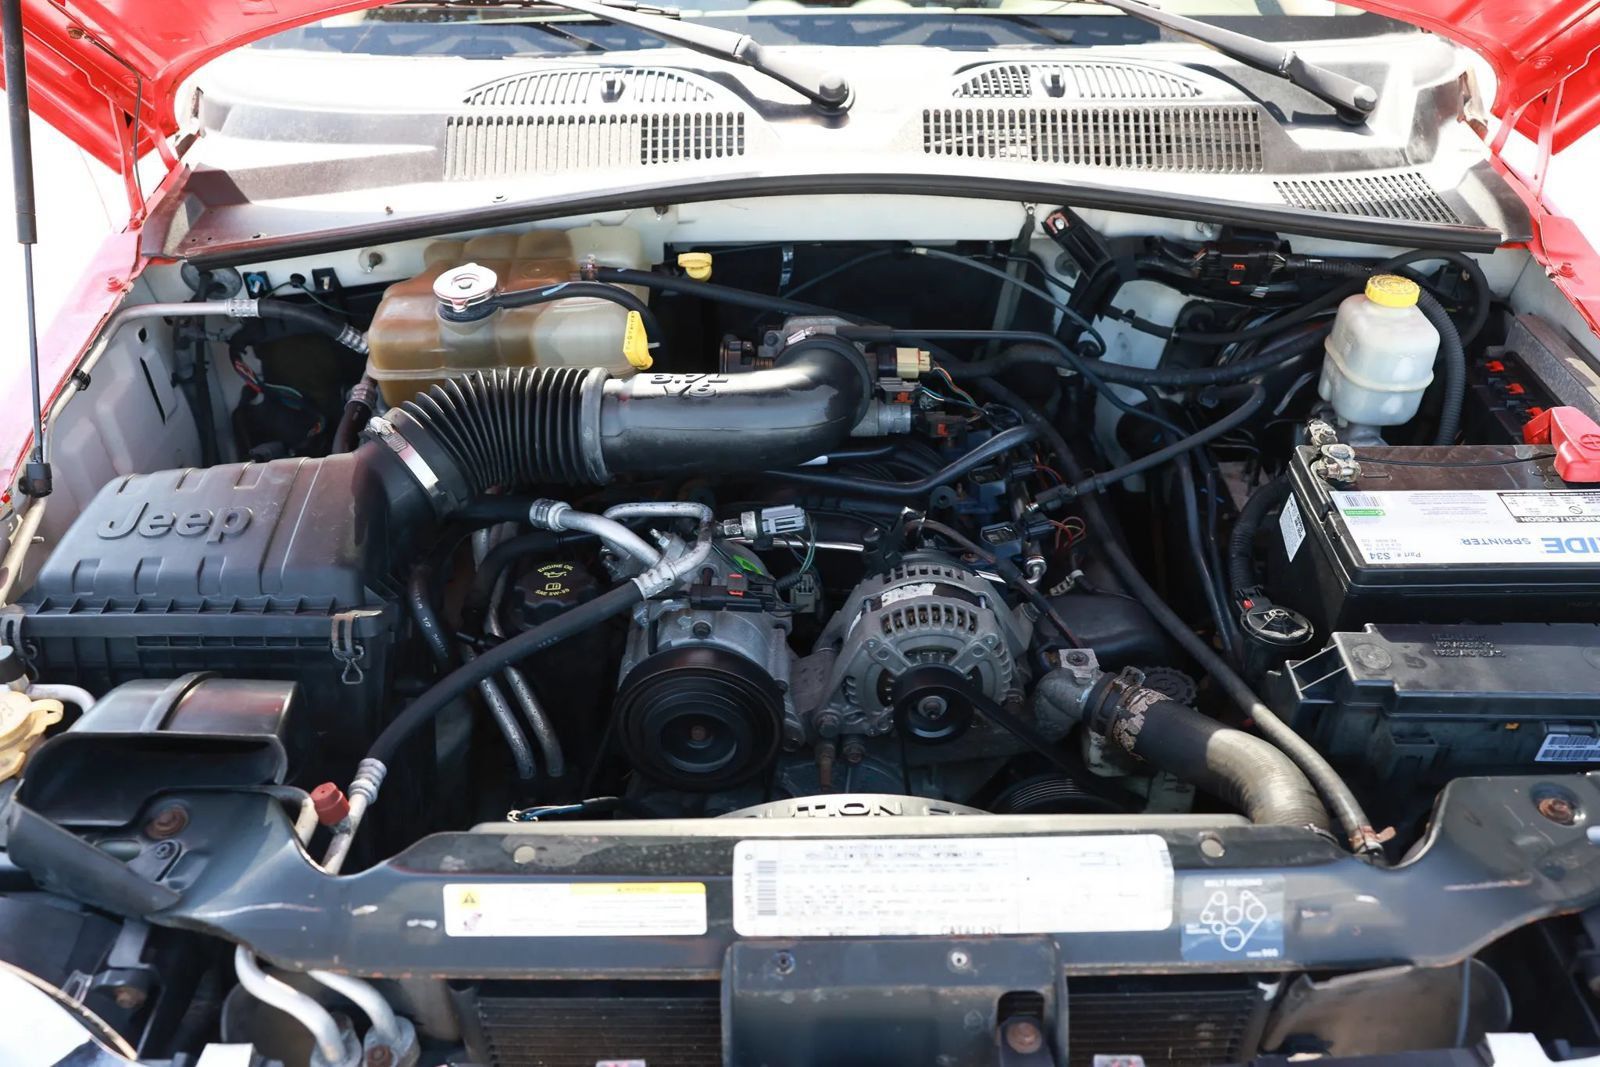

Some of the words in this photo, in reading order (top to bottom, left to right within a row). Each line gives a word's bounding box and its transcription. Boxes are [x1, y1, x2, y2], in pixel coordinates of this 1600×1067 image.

[97, 502, 253, 545] Jeep
[1461, 537, 1532, 546] SPRINTER
[1541, 537, 1600, 554] IDE
[1369, 552, 1391, 561] S34
[537, 564, 563, 573] ENGINE
